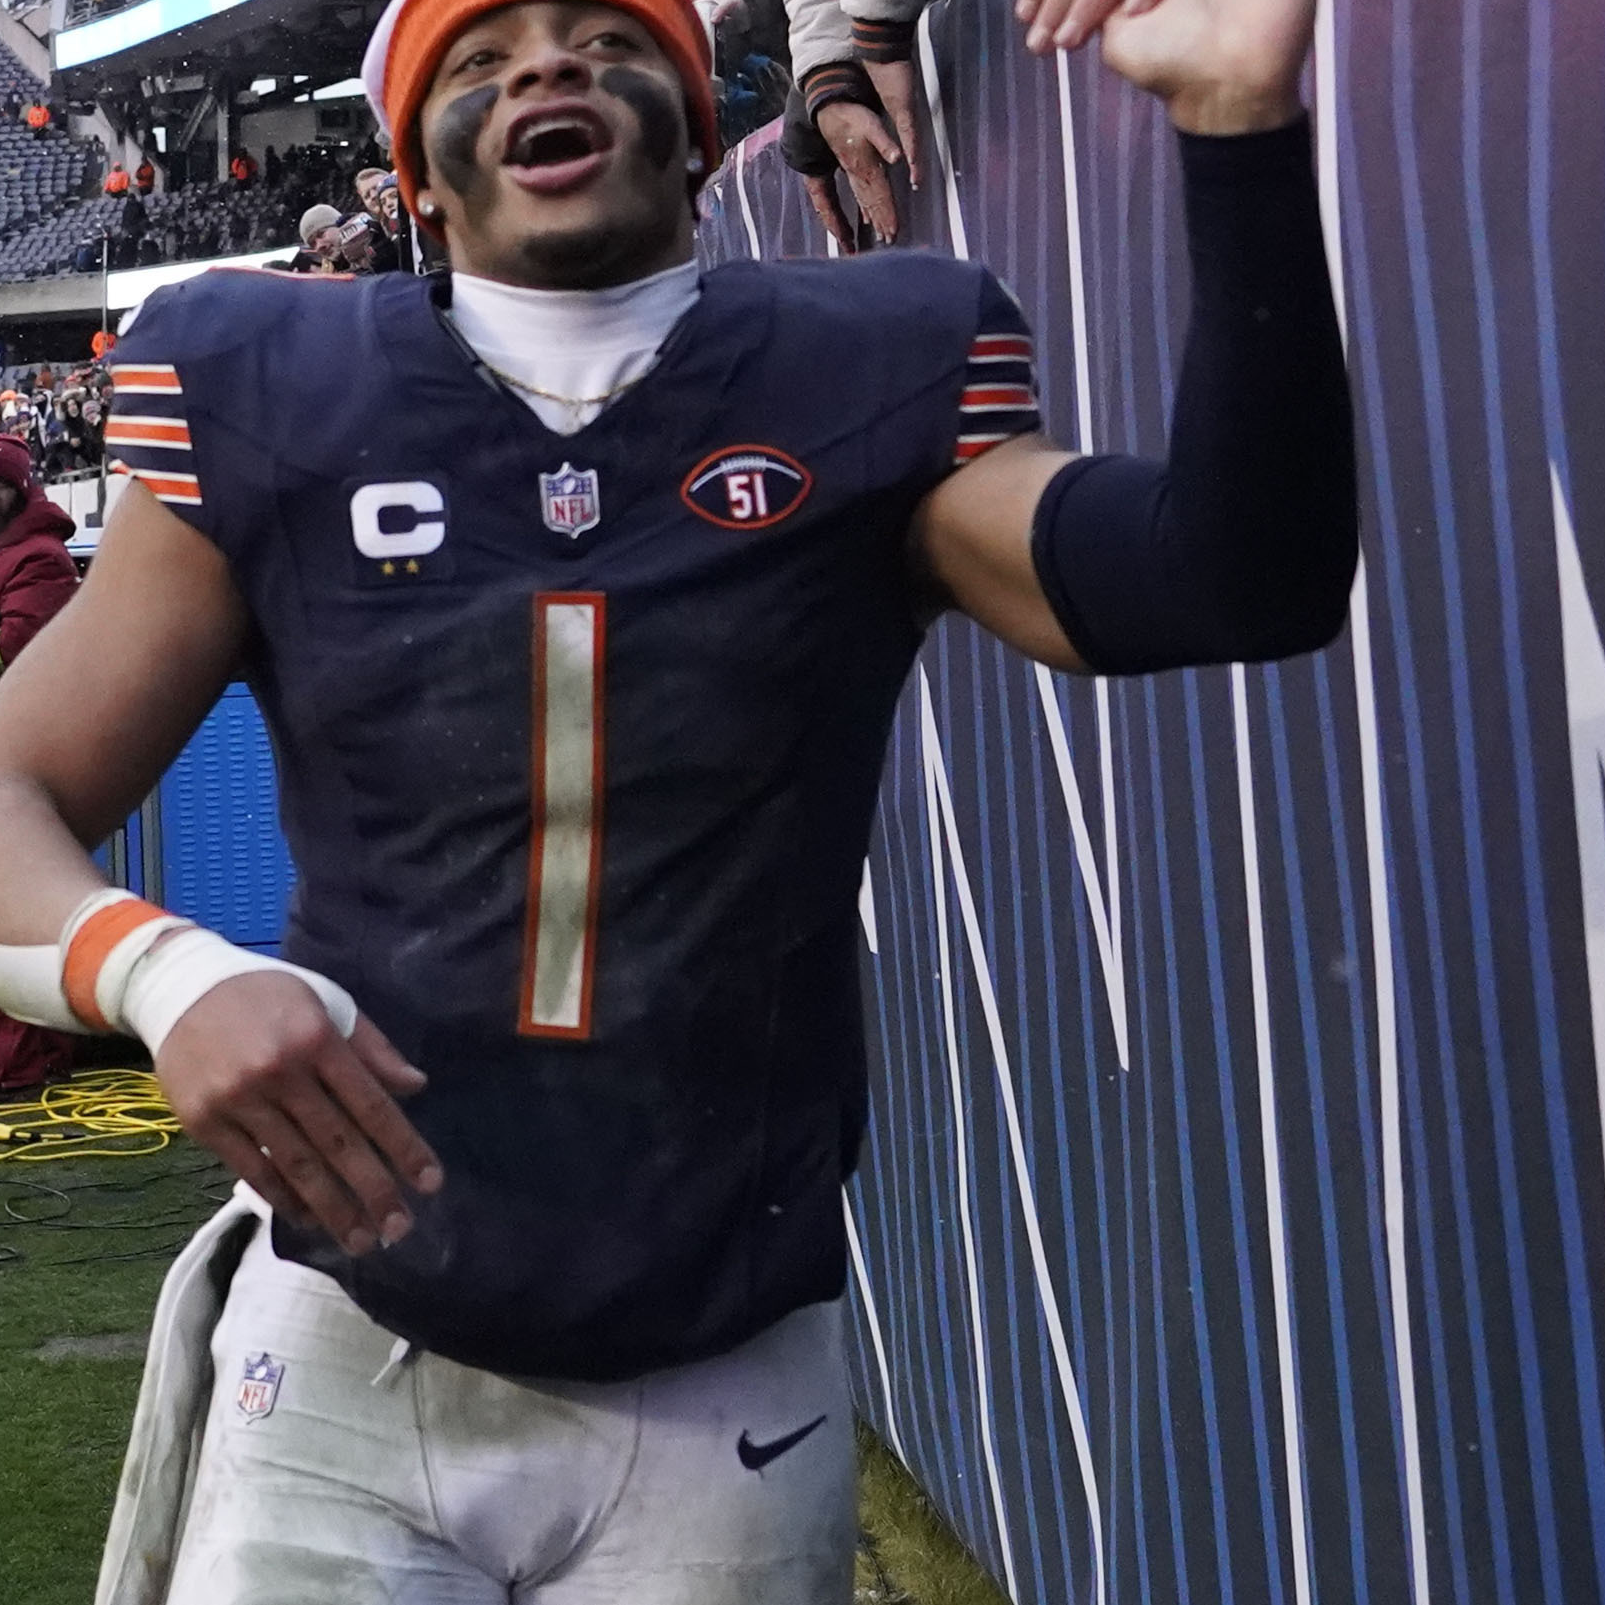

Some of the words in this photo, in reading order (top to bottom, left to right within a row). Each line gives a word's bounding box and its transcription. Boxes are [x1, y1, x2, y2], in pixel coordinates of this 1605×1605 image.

[551, 498, 592, 524] NFL
[726, 473, 767, 519] 51
[350, 481, 444, 558] C
[518, 591, 605, 1039] 1
[241, 1384, 267, 1408] NFL
